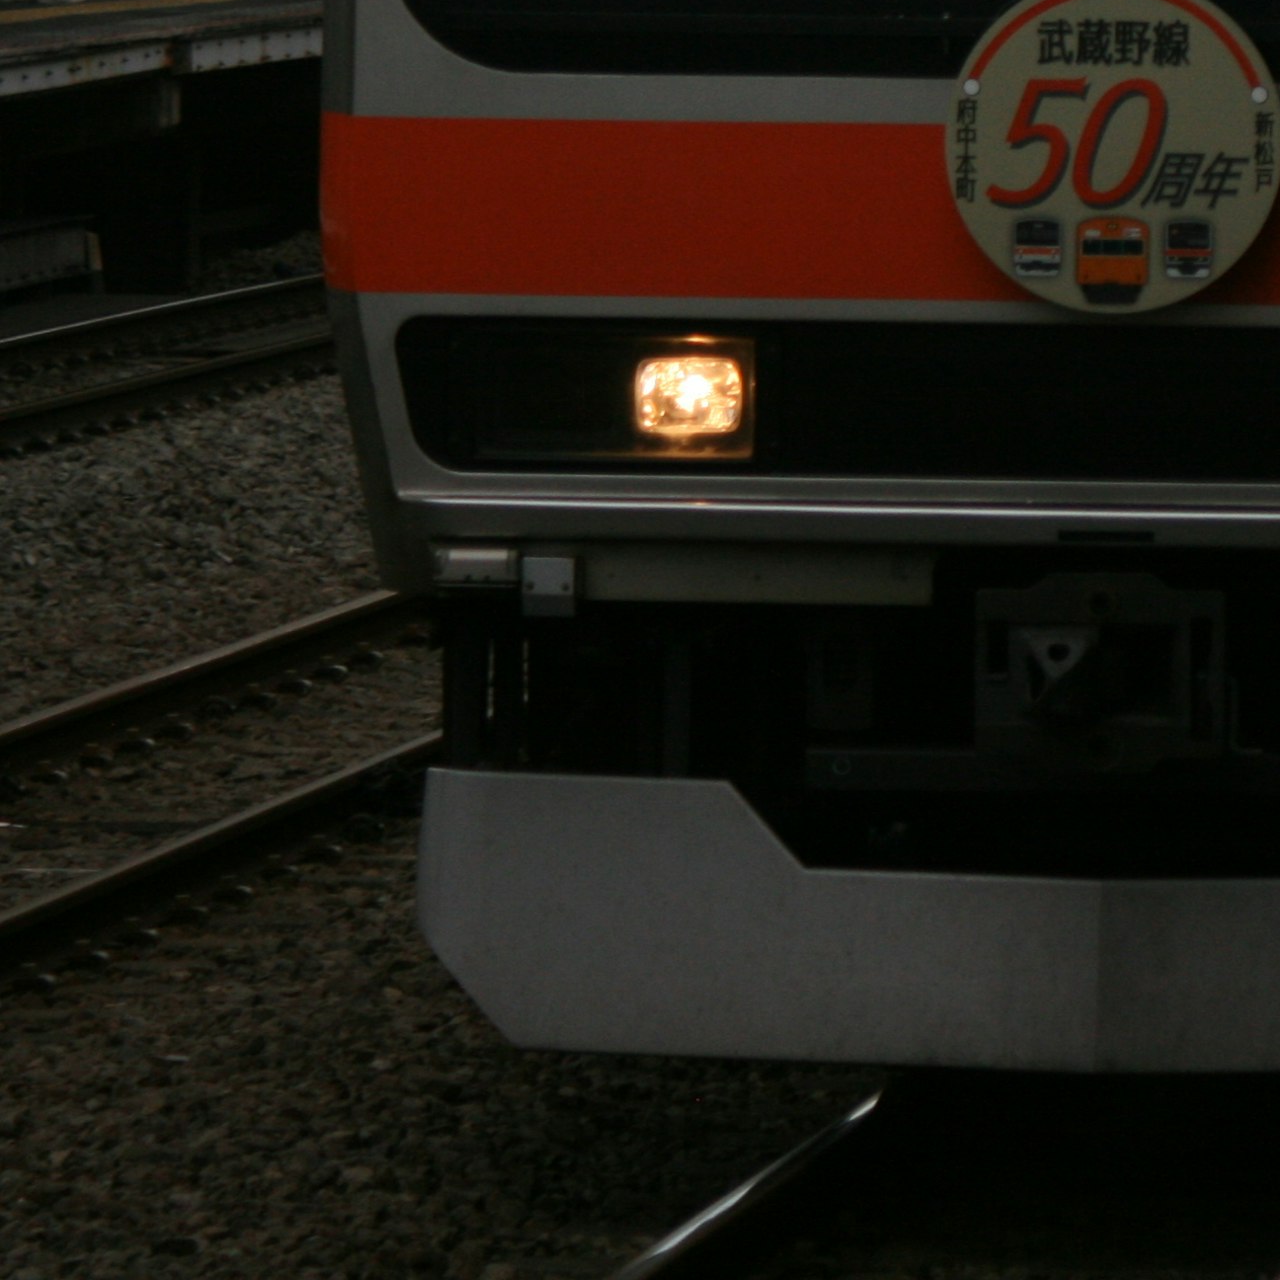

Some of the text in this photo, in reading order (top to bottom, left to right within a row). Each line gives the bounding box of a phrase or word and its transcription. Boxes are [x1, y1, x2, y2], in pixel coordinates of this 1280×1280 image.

[1037, 19, 1191, 66] 武蔵野線
[955, 97, 978, 204] 府中本町
[1254, 111, 1276, 193] 新松戸
